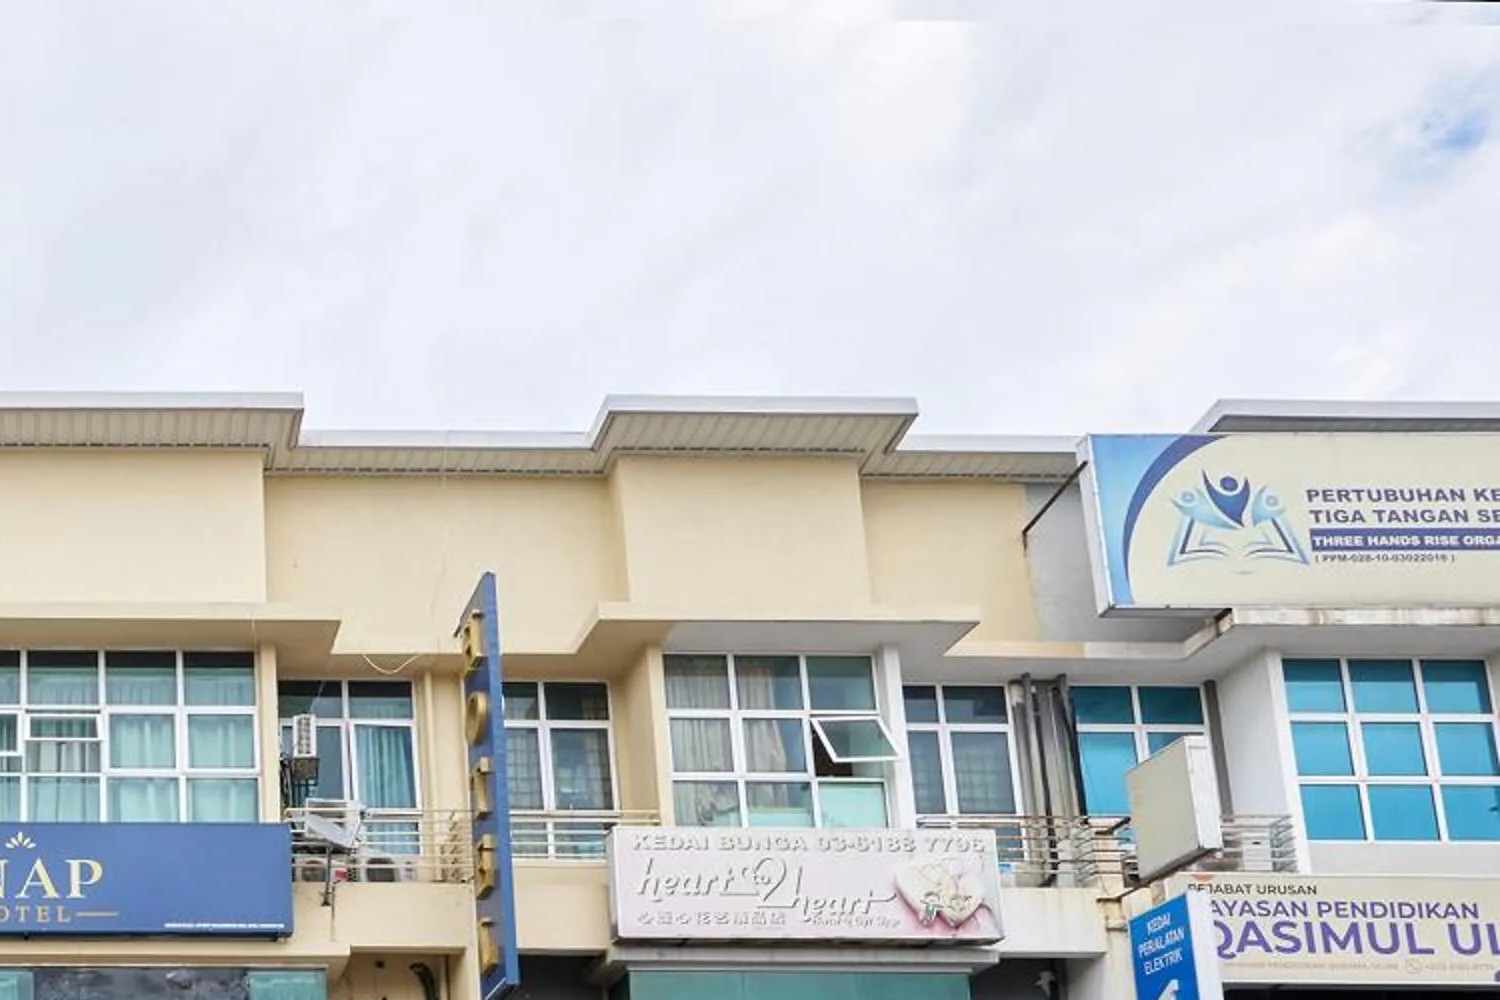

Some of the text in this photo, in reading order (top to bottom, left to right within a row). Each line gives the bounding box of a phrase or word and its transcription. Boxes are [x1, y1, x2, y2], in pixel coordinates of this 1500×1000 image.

[1305, 488, 1465, 503] PERTUBUHAN
[1309, 509, 1367, 523] TIGA
[1372, 509, 1470, 523] TANGAN
[1313, 535, 1500, 547] THREE HANDS RISE ORG
[633, 834, 710, 851] KEDAI
[716, 835, 810, 852] BUNGA
[1256, 884, 1318, 896] URUSAN
[1211, 899, 1480, 920] AYASAN PENDIDIKAN
